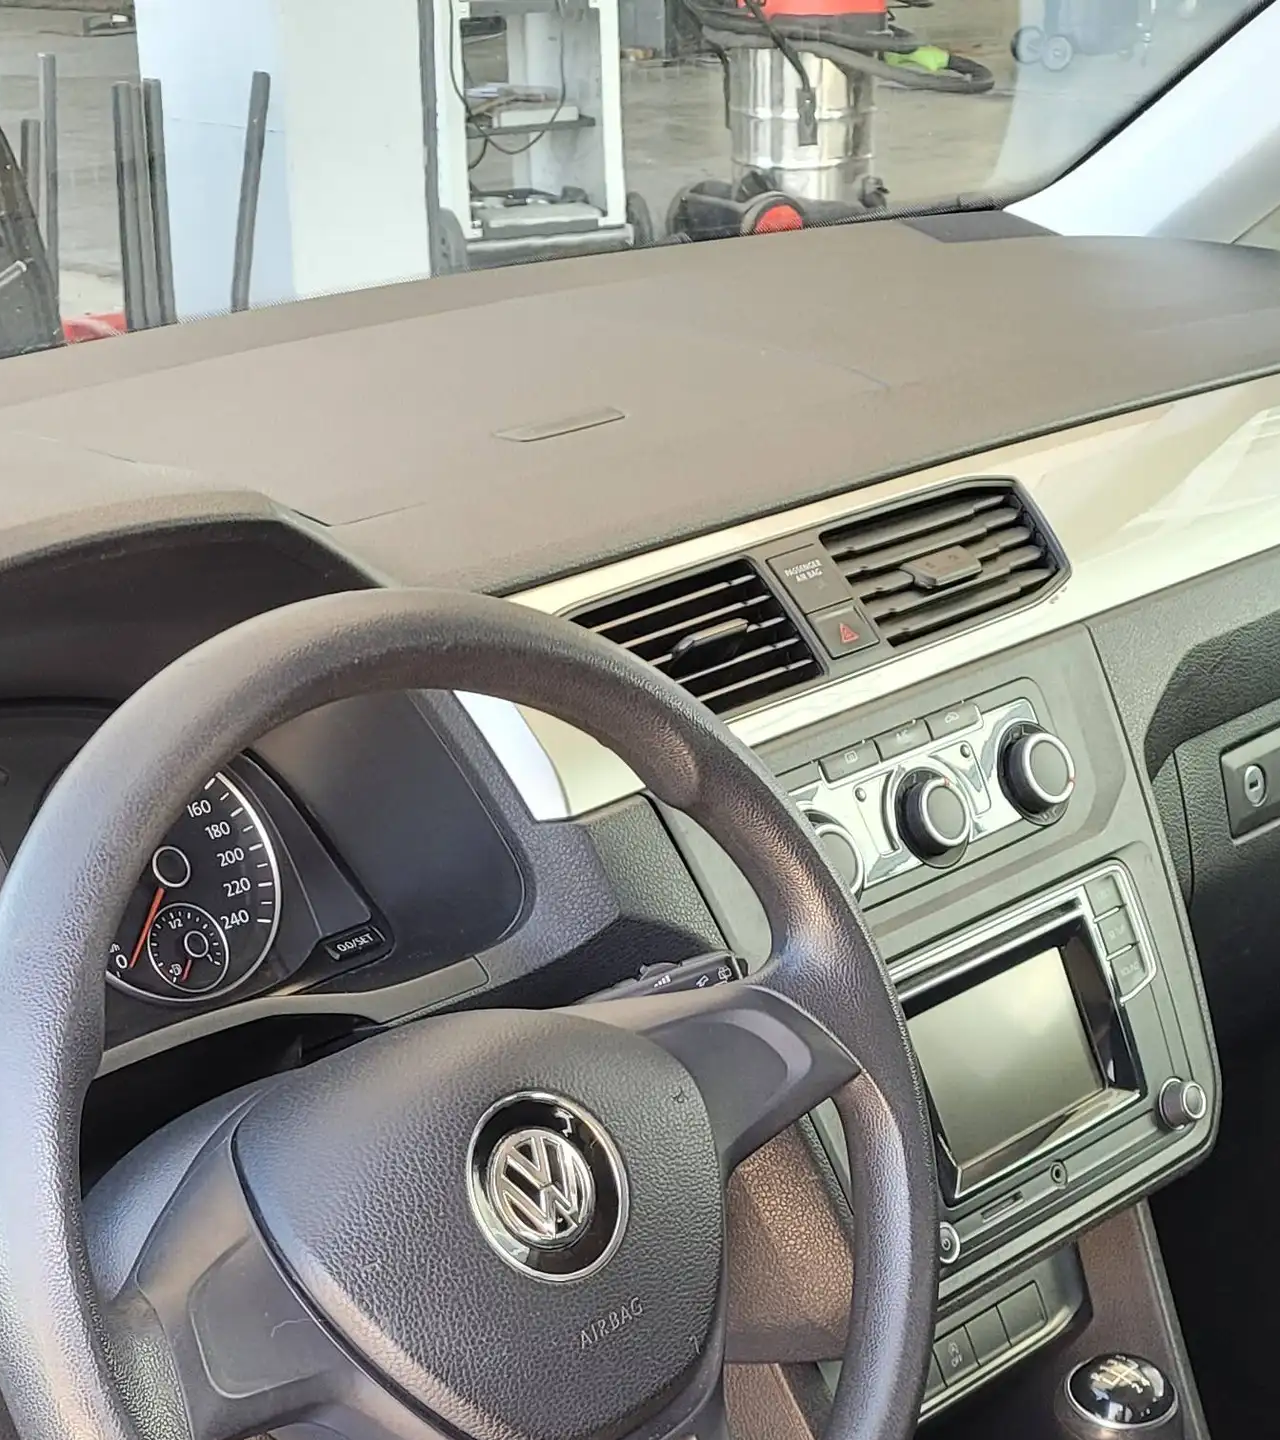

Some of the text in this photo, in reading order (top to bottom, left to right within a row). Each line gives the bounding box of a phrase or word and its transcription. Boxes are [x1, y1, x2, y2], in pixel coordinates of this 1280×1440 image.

[186, 800, 211, 818] 160
[205, 821, 230, 840] 180
[217, 847, 244, 867] 200
[223, 877, 251, 897] 220
[221, 909, 250, 930] 240
[115, 954, 128, 969] 0
[578, 1297, 645, 1349] AIRBAG
